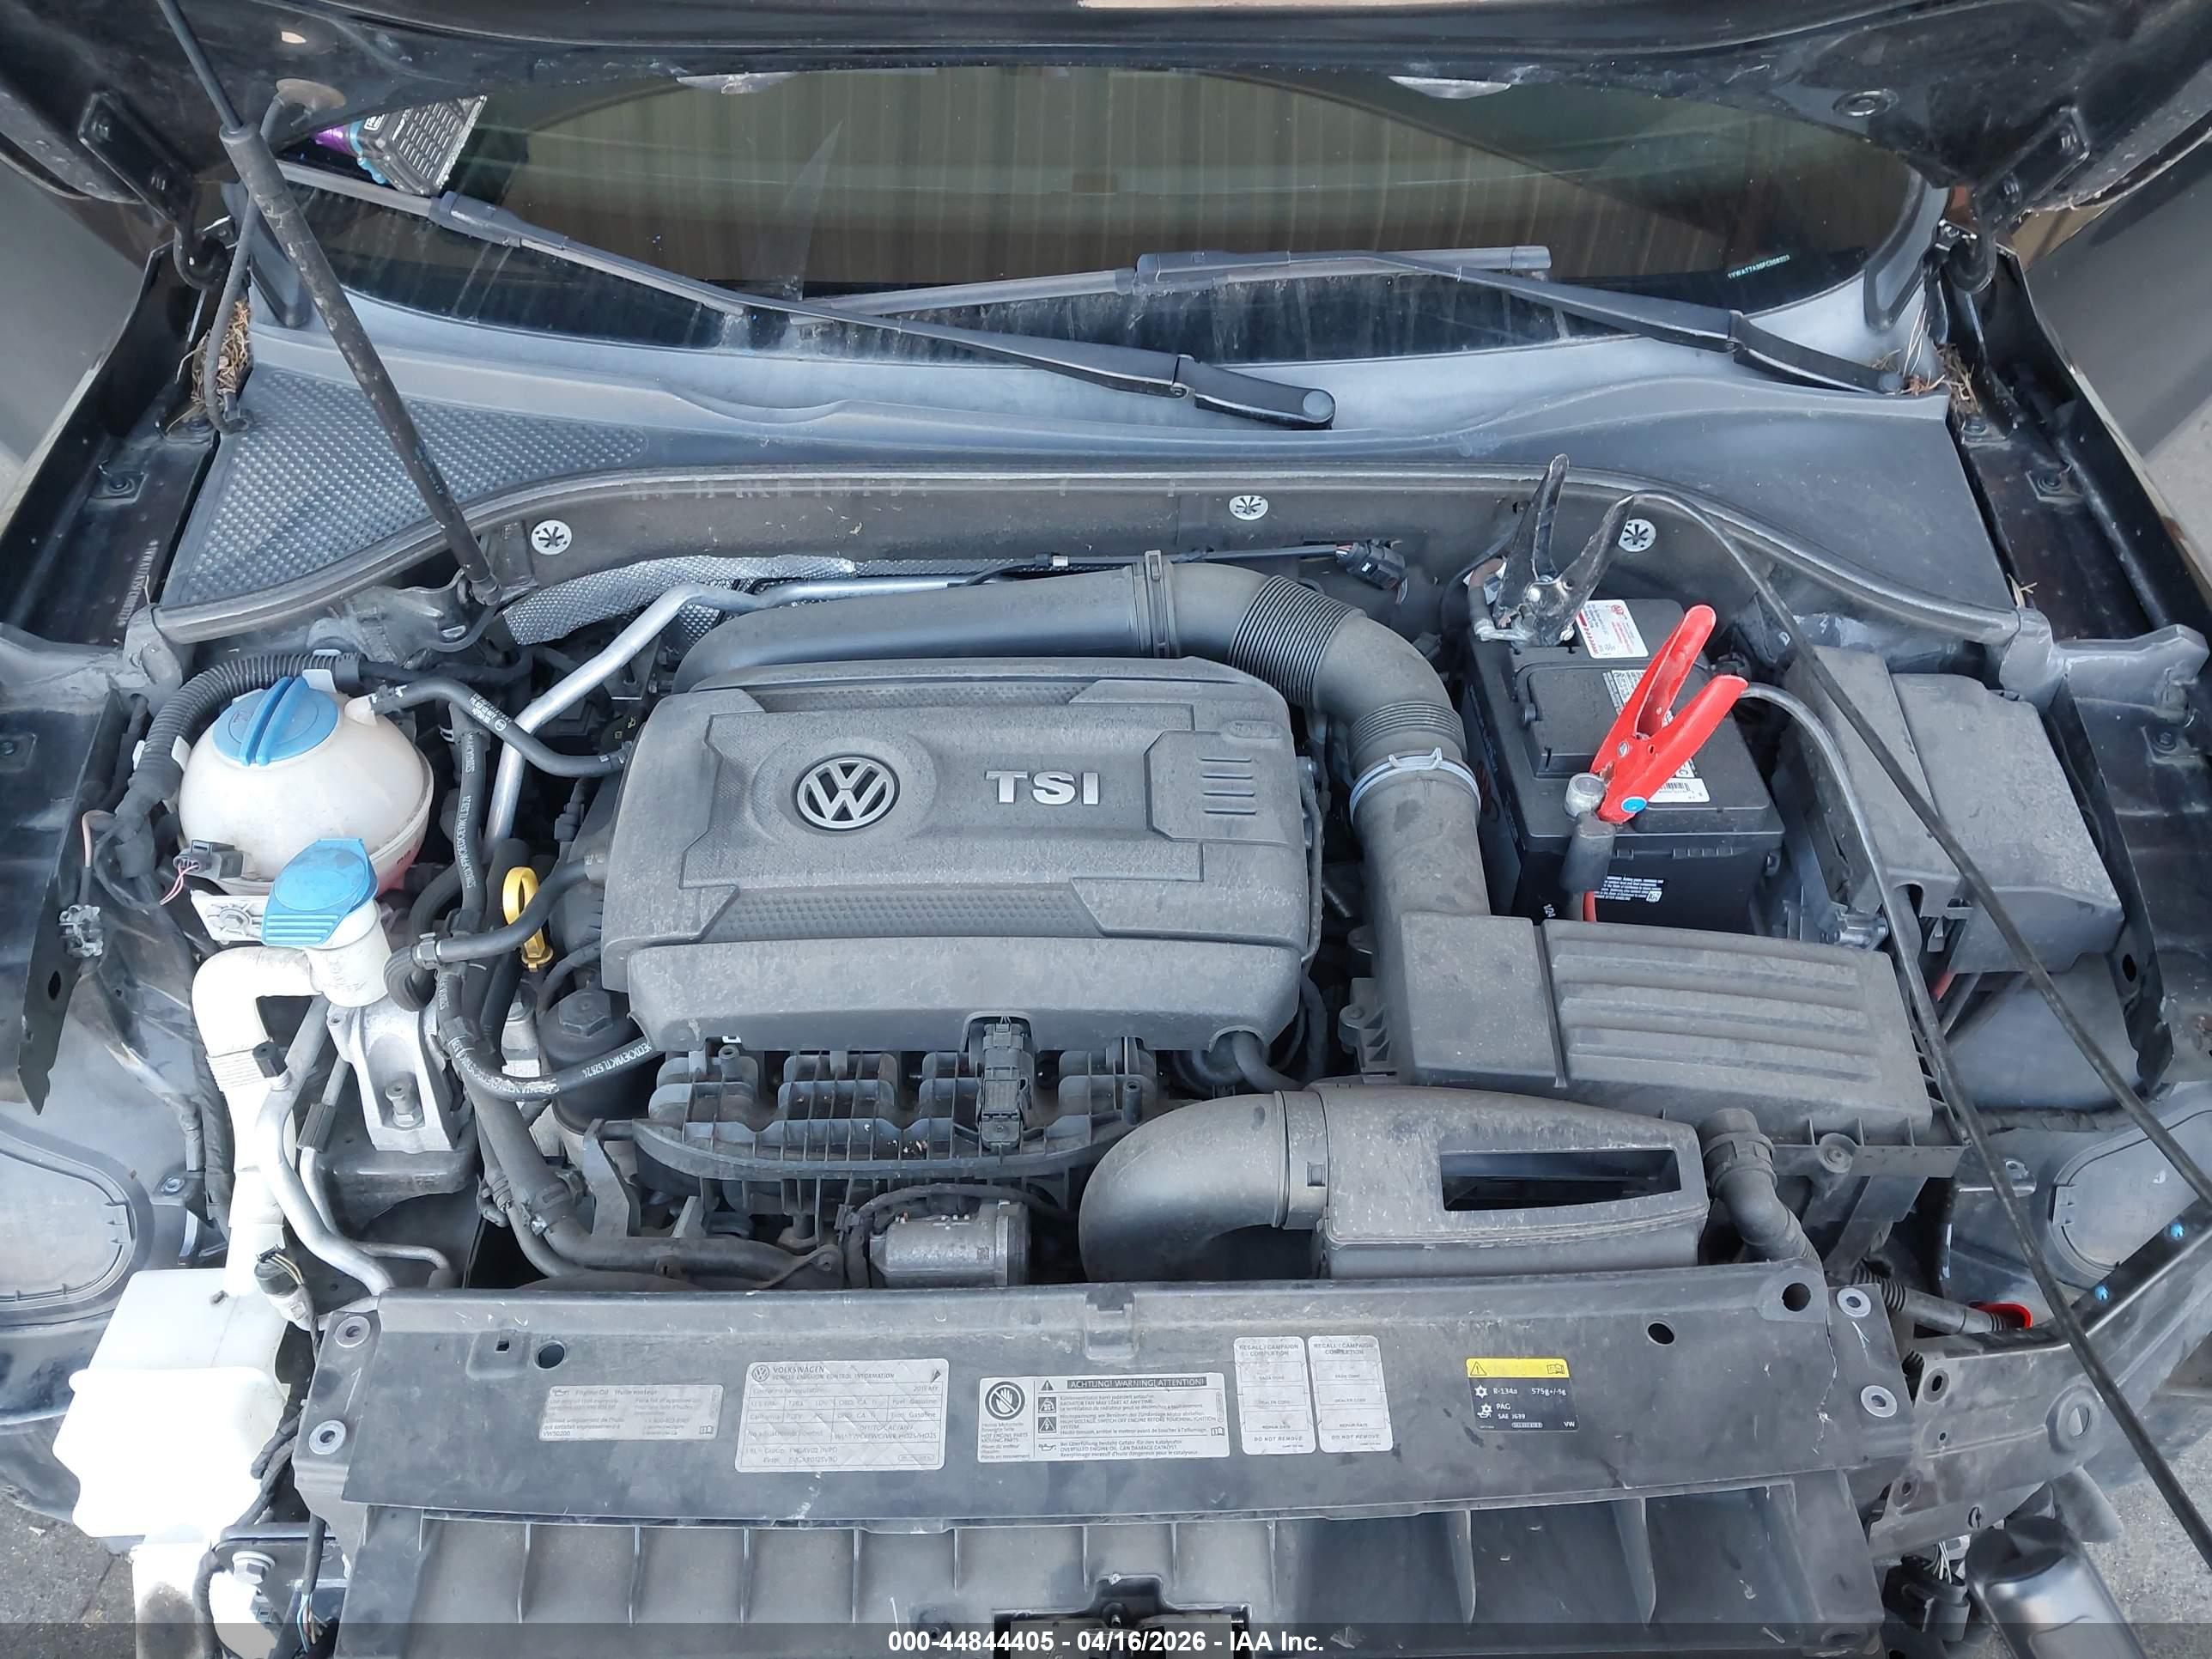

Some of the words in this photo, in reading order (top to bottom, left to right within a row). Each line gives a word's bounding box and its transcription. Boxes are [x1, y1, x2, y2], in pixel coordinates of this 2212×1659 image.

[986, 770, 1102, 805] TSI
[773, 1365, 825, 1374] VOLKSWAGEN
[1070, 1380, 1113, 1389] ACHTUNG!
[1158, 1378, 1204, 1387] ATTENTION!
